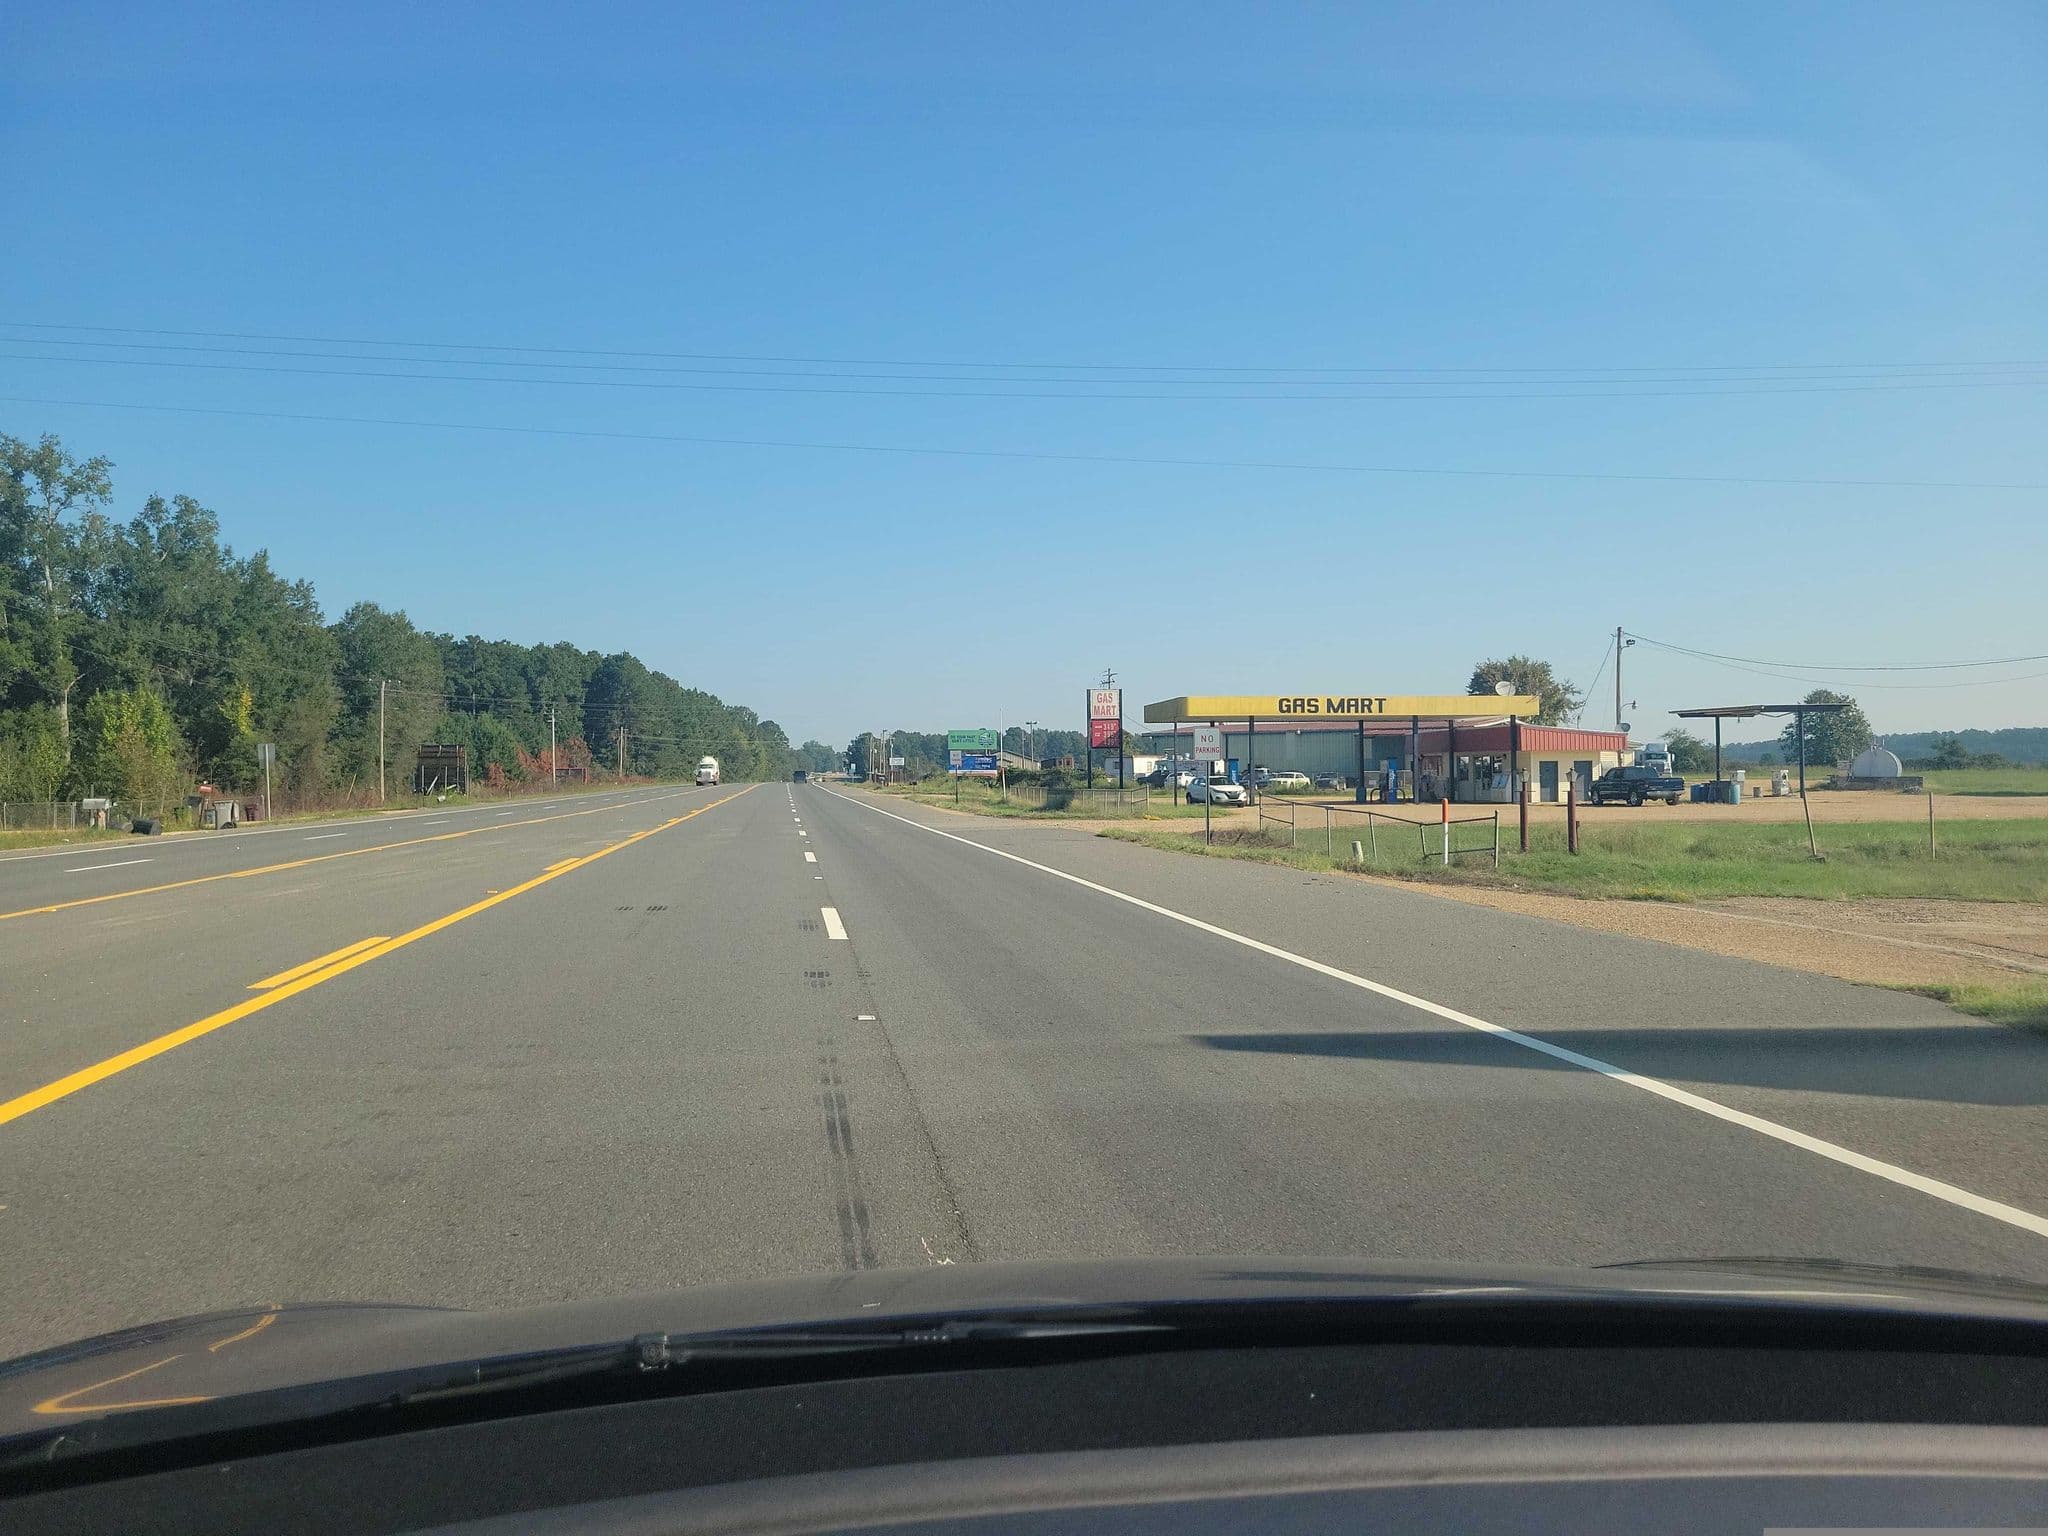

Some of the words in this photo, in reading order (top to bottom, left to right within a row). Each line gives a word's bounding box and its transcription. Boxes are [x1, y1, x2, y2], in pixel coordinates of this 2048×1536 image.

[1097, 692, 1113, 704] GAS
[1093, 705, 1117, 716] MART
[1278, 697, 1319, 714] GAS
[1326, 697, 1387, 714] MART
[1200, 734, 1214, 743] NO
[1195, 746, 1220, 754] PARKING
